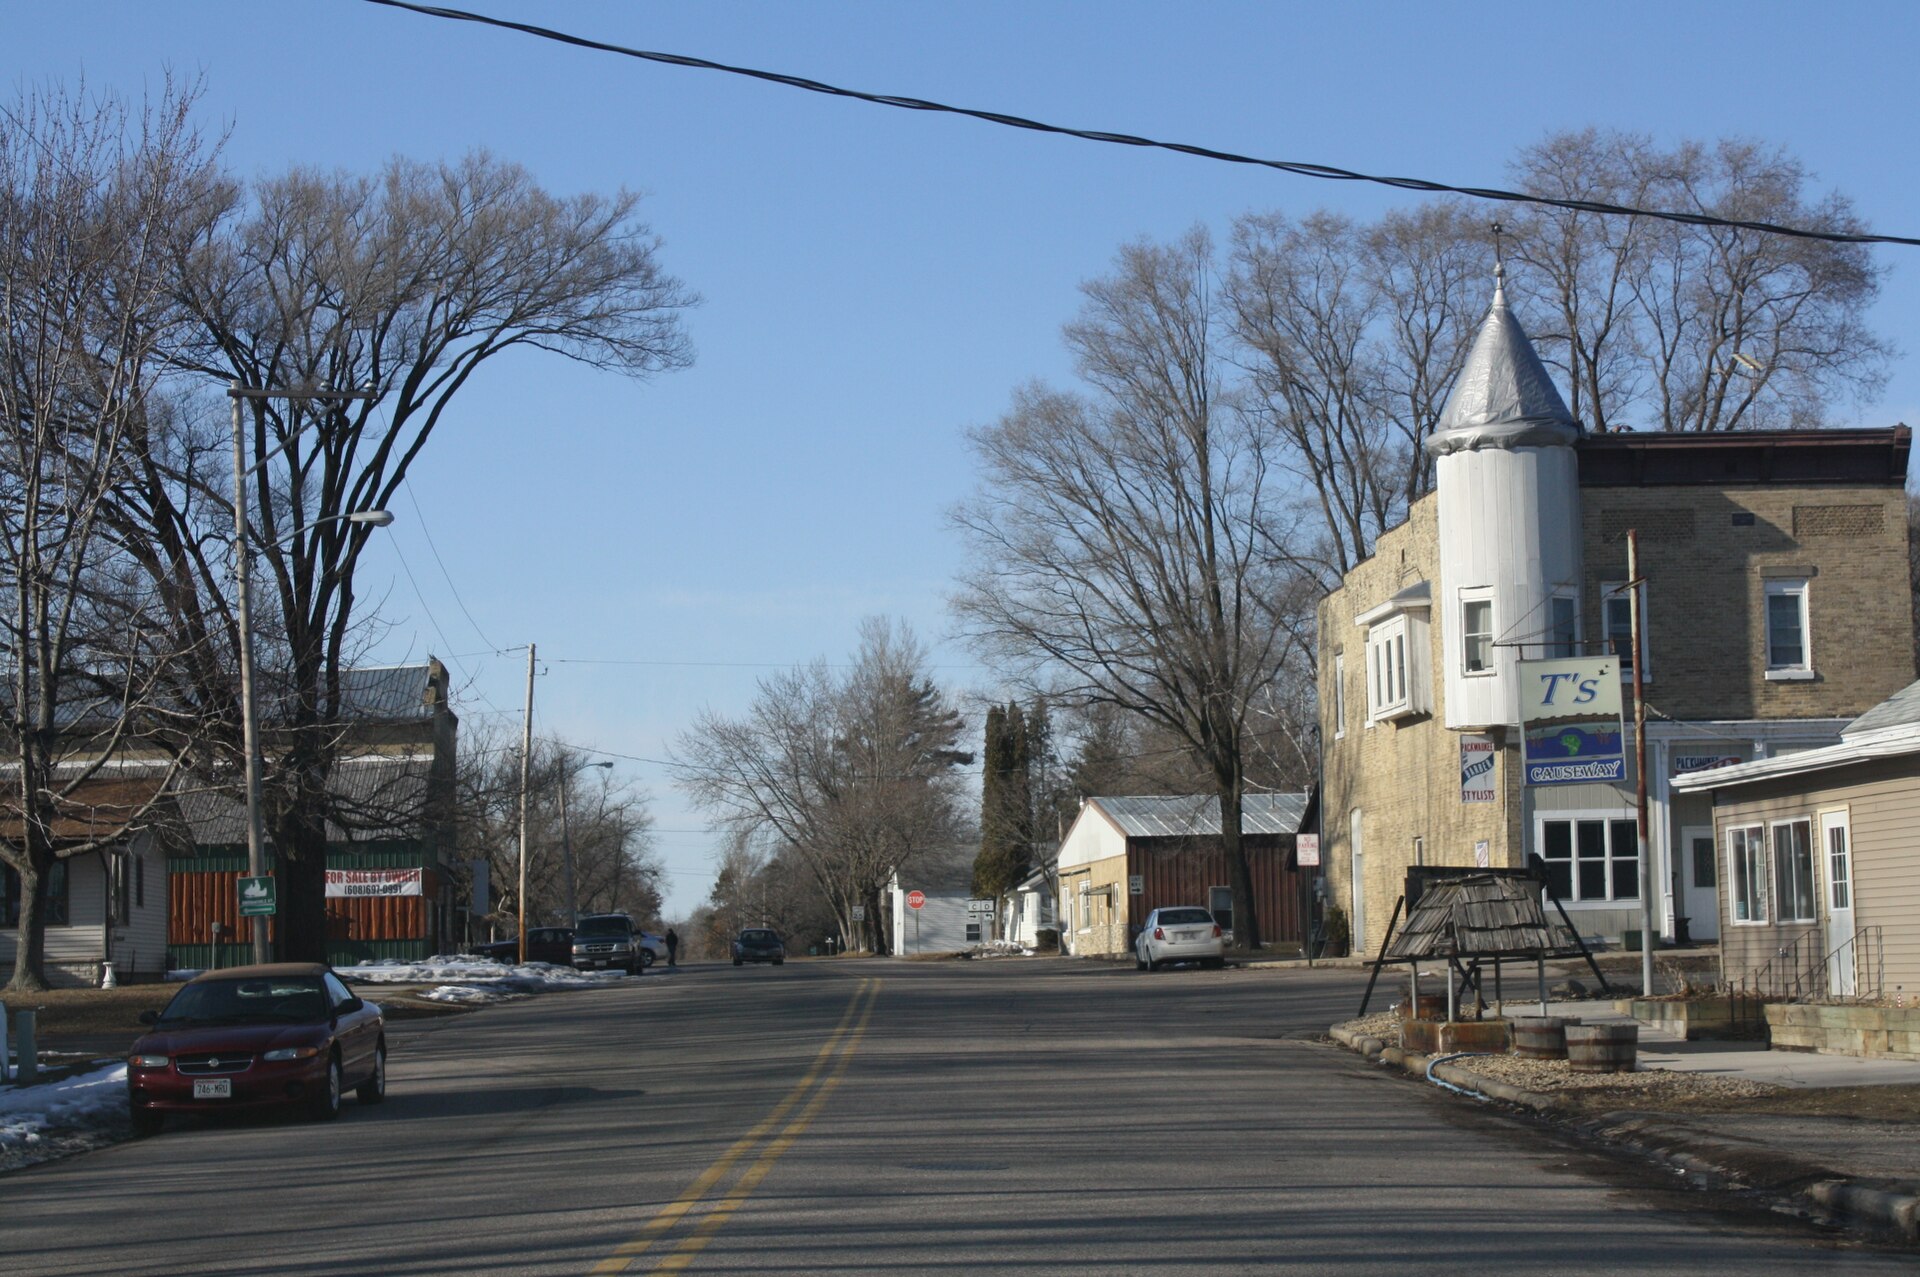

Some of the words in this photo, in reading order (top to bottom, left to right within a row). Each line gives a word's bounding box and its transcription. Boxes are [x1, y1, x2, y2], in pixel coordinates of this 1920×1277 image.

[1540, 672, 1600, 706] T's
[1464, 758, 1493, 779] BARBER
[1531, 760, 1621, 782] CAUSEWAY
[1462, 790, 1495, 801] STYLISTS
[325, 871, 343, 884] FOR
[346, 871, 368, 884] SALE
[371, 871, 383, 883] BY
[385, 870, 420, 883] OWNER
[908, 896, 923, 904] STOP
